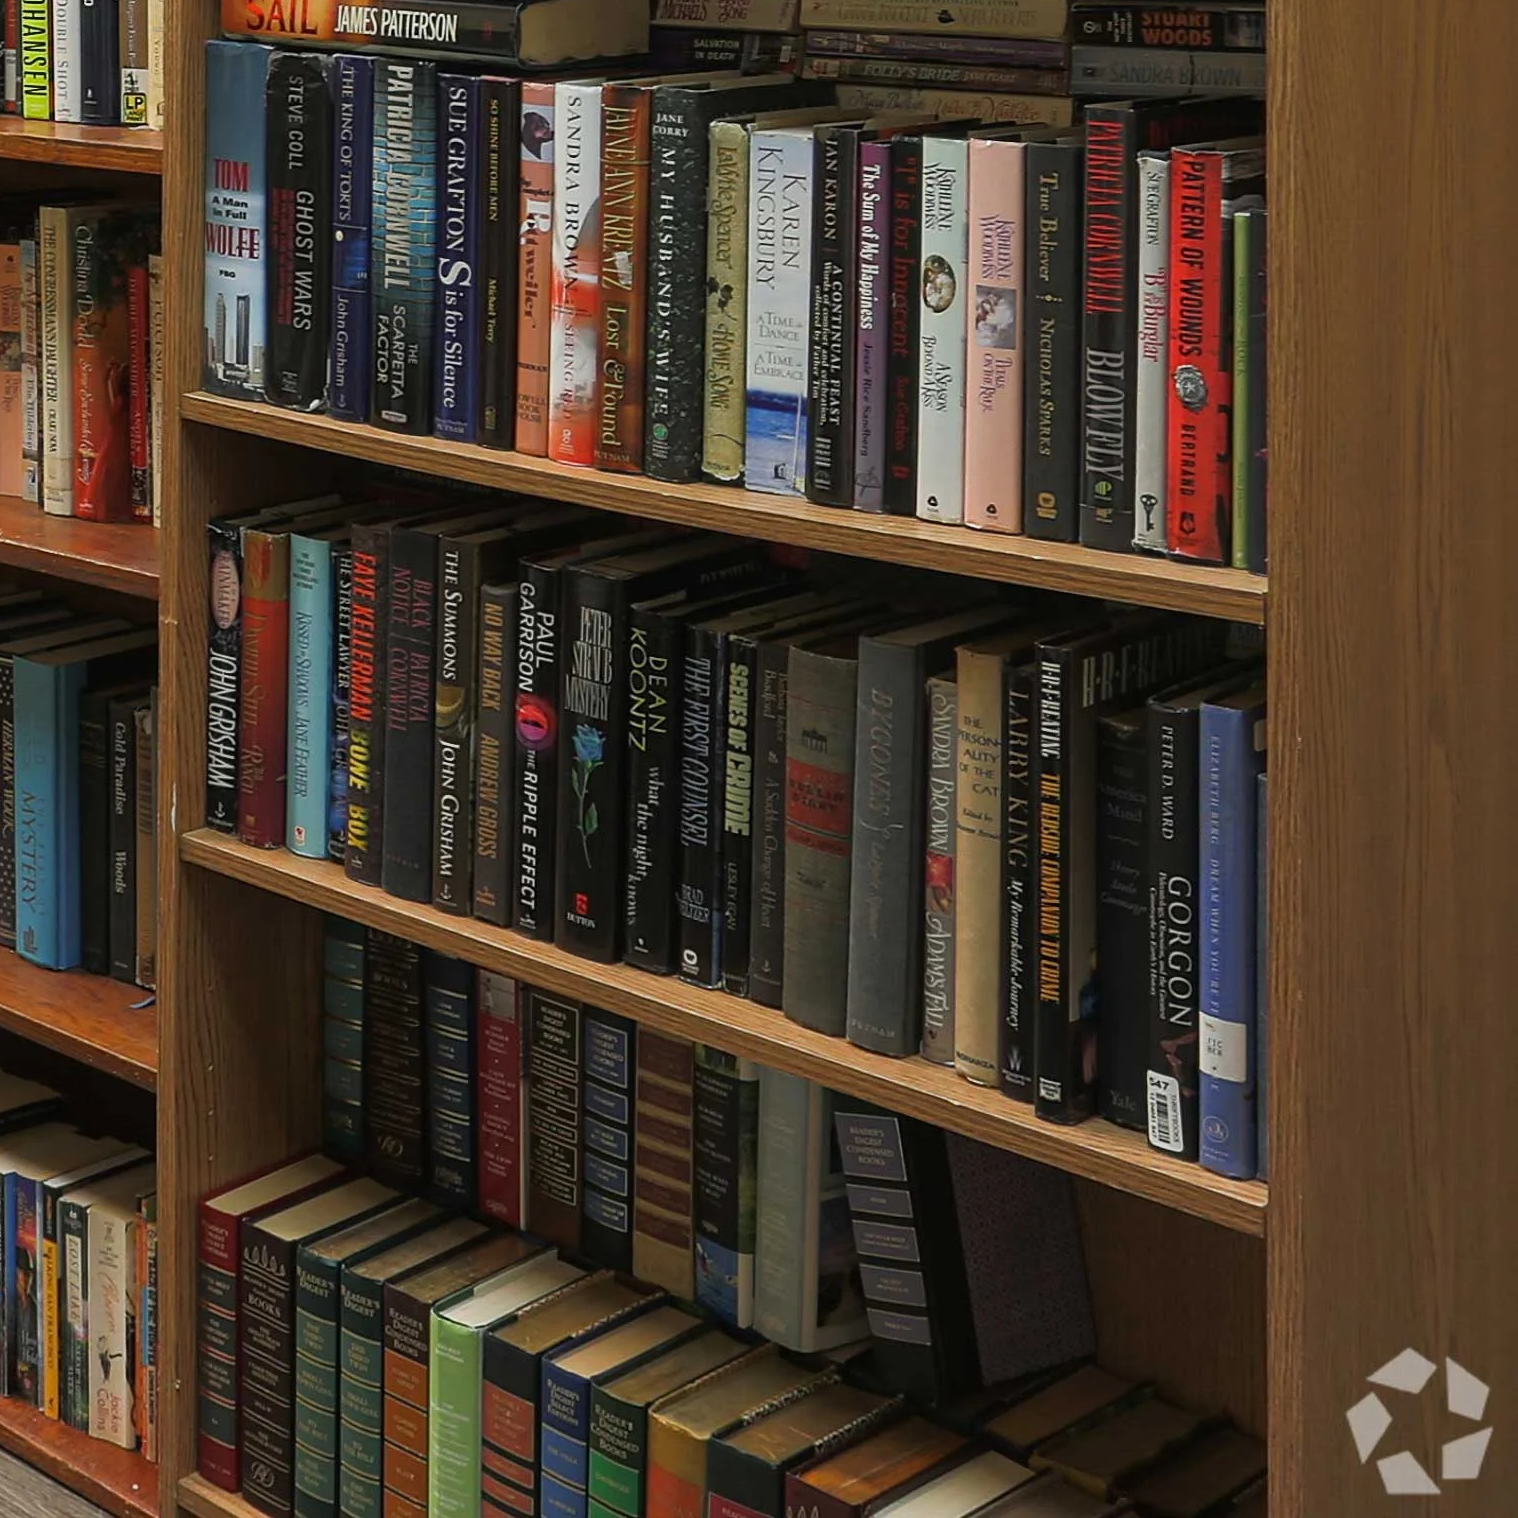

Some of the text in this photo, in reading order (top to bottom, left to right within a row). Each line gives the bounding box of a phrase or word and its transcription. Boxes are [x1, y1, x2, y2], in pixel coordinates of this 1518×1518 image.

[333, 4, 459, 43] JAMES PATTERSON
[213, 158, 250, 192] TOM
[288, 75, 304, 171] STEVE COLL
[205, 220, 259, 261] WOLFE
[294, 190, 315, 331] GHOST WARS
[755, 146, 783, 289] KINGSBURY
[781, 174, 806, 271] KAREN
[1178, 160, 1204, 357] PATTERN OF WOUNDS
[75, 224, 93, 348] Christina Dodd
[376, 315, 389, 383] FACTOR
[390, 305, 406, 399] SCARPETTA
[1179, 424, 1197, 496] BERTRAND
[443, 551, 461, 680] THE SUMMONS
[517, 582, 535, 694] GARRISON
[536, 611, 555, 668] PAUL
[209, 650, 237, 789] JOHN GRISHAM
[629, 628, 647, 752] KOONTZ
[647, 656, 668, 733] DEAN
[439, 738, 460, 876] JOHN GRISHAM
[725, 752, 752, 836] CRIME
[1008, 688, 1029, 868] LARRY KING
[21, 790, 36, 913] MYSTERY
[522, 773, 537, 909] RIPPLE EFFECT
[1168, 874, 1195, 1027] GORGON
